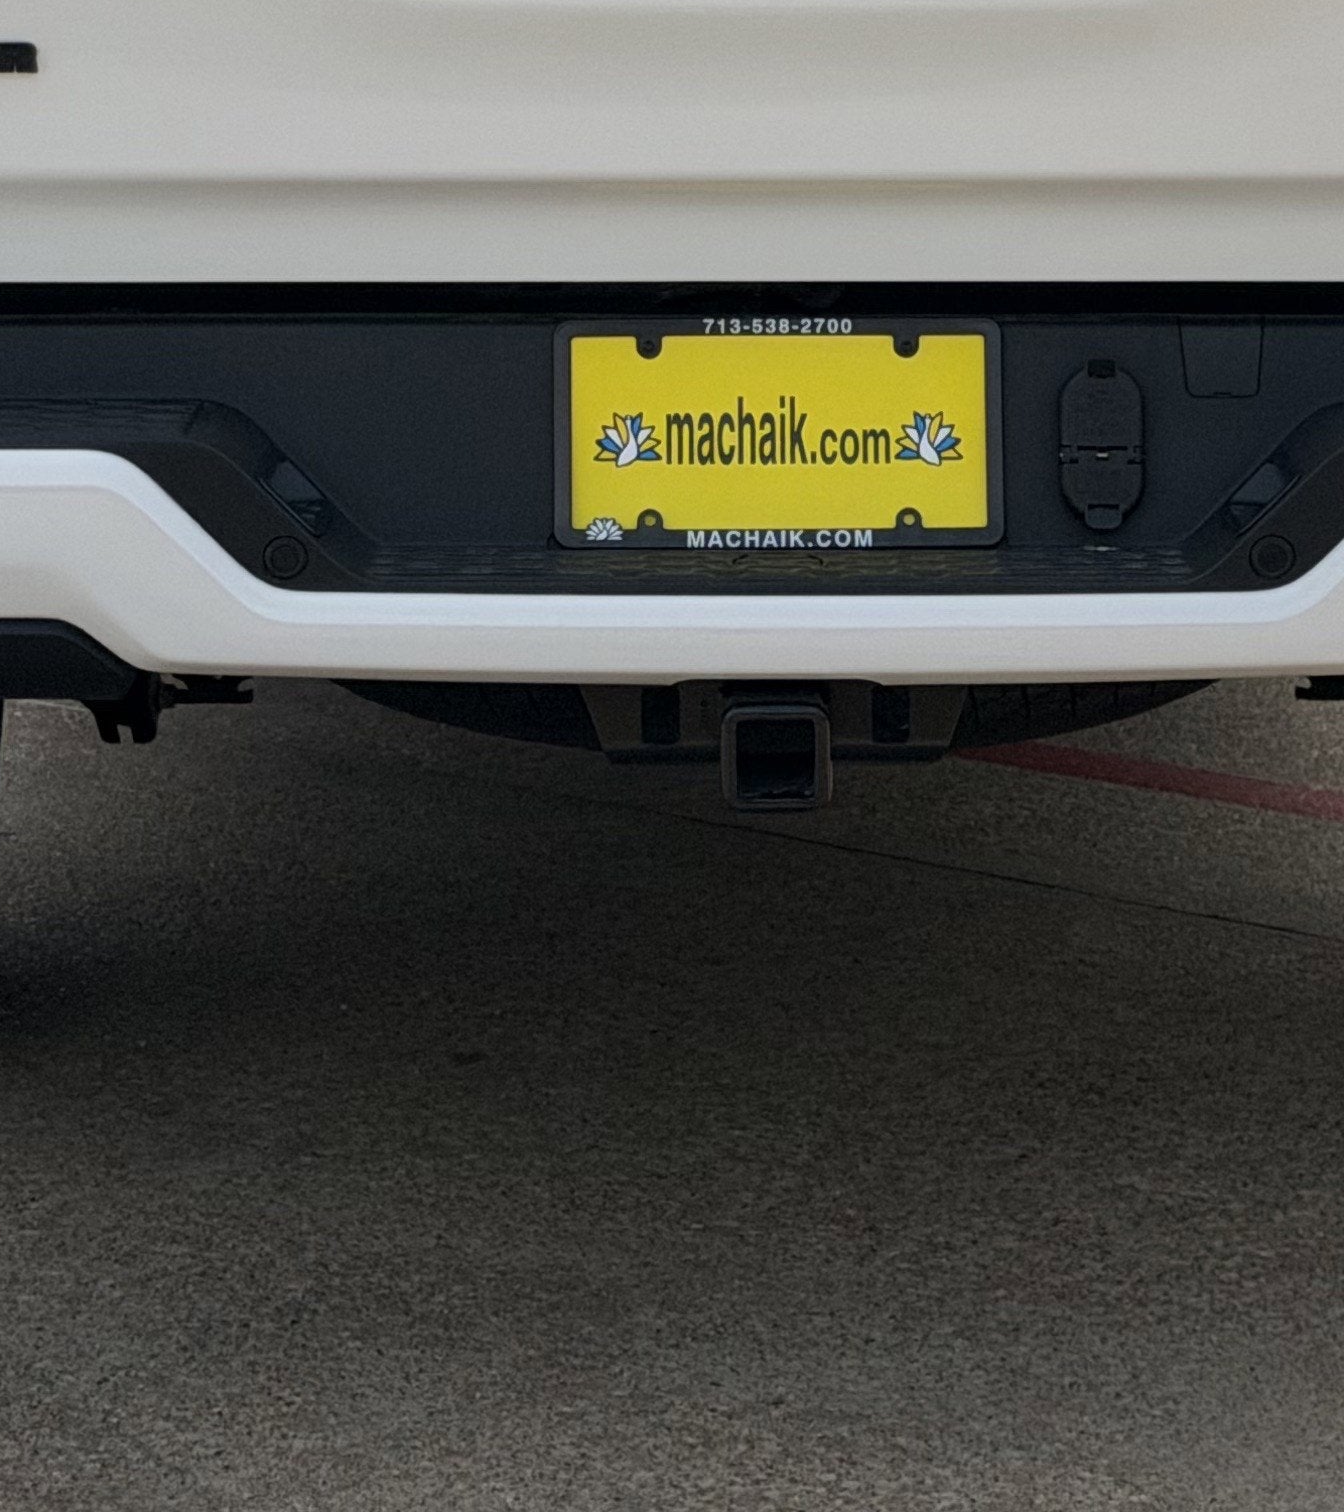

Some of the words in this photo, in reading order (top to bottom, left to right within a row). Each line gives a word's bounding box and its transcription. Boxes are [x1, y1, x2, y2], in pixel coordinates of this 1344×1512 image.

[702, 318, 853, 335] 713-538-2700
[665, 396, 892, 466] machaik.com
[686, 529, 874, 549] MACHAIK.COM
